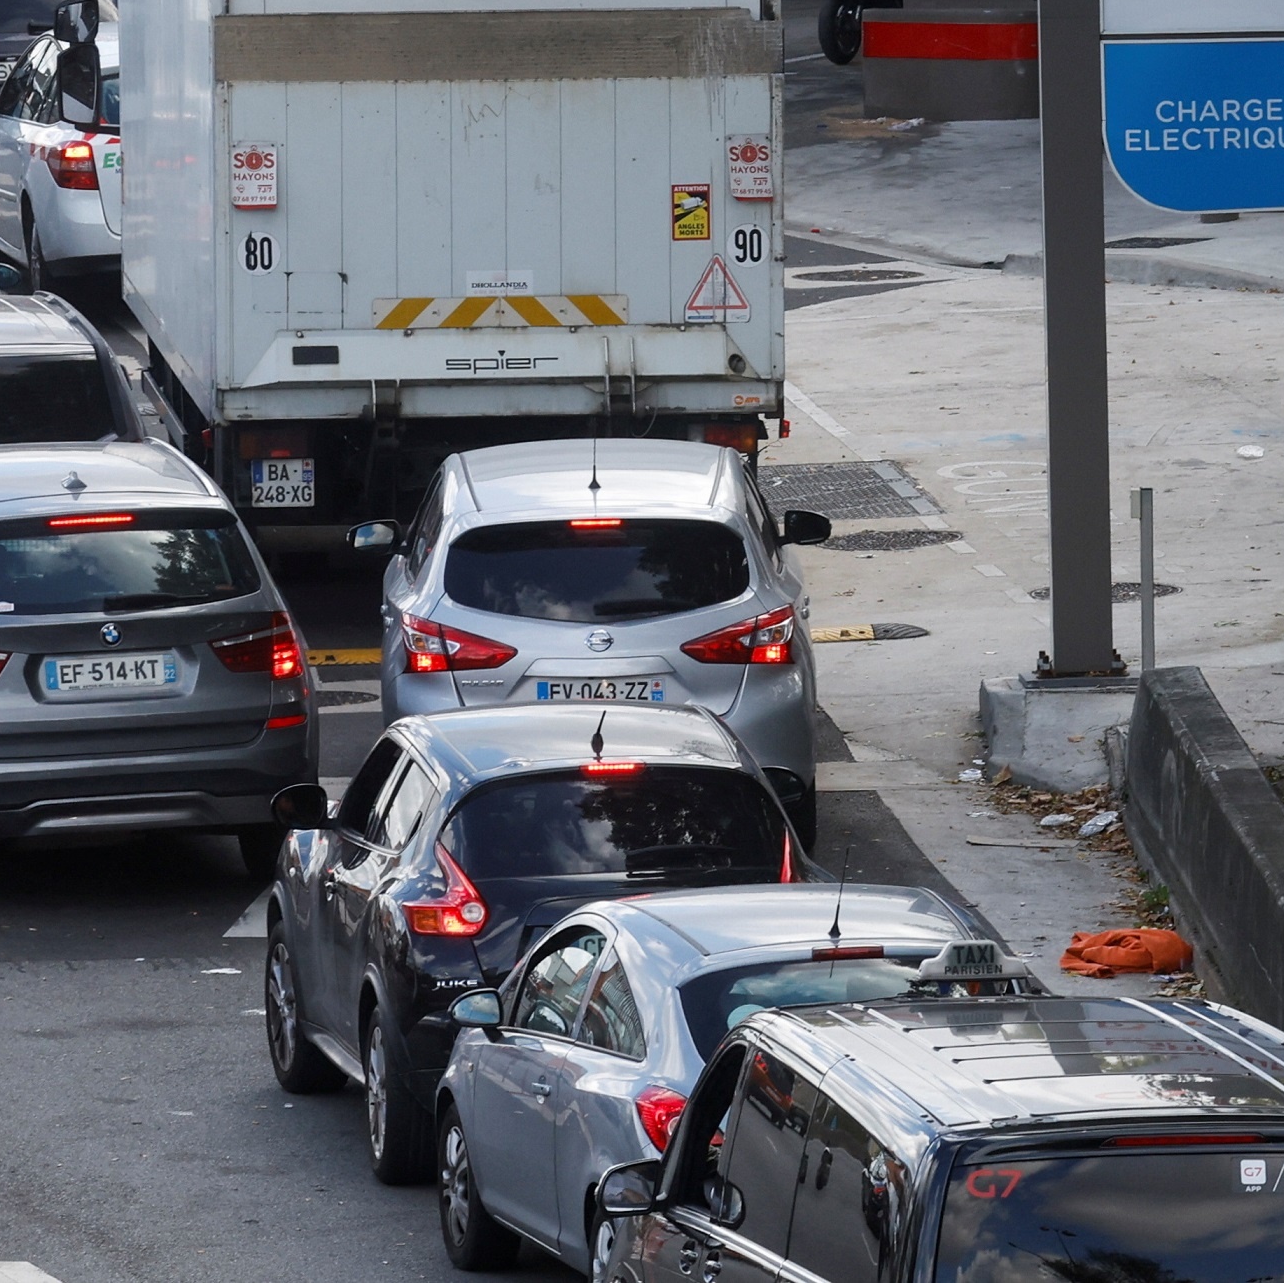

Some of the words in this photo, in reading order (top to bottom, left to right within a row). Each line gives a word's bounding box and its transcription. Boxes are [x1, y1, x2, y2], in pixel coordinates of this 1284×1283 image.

[1156, 99, 1284, 123] CHARGE
[233, 150, 275, 171] SOS
[729, 143, 769, 164] SOS
[234, 173, 275, 181] HAYONS
[731, 166, 769, 174] HAYONS
[245, 236, 272, 271] 80
[735, 229, 762, 263] 90
[471, 281, 528, 289] DHOLLANDIA
[446, 350, 558, 375] spier
[254, 485, 312, 503] 248-XG
[164, 669, 176, 679] 22
[953, 945, 995, 964] TAXI
[944, 965, 1003, 975] PARISIEN
[1244, 1167, 1262, 1177] G7
[966, 1169, 1023, 1198] G7
